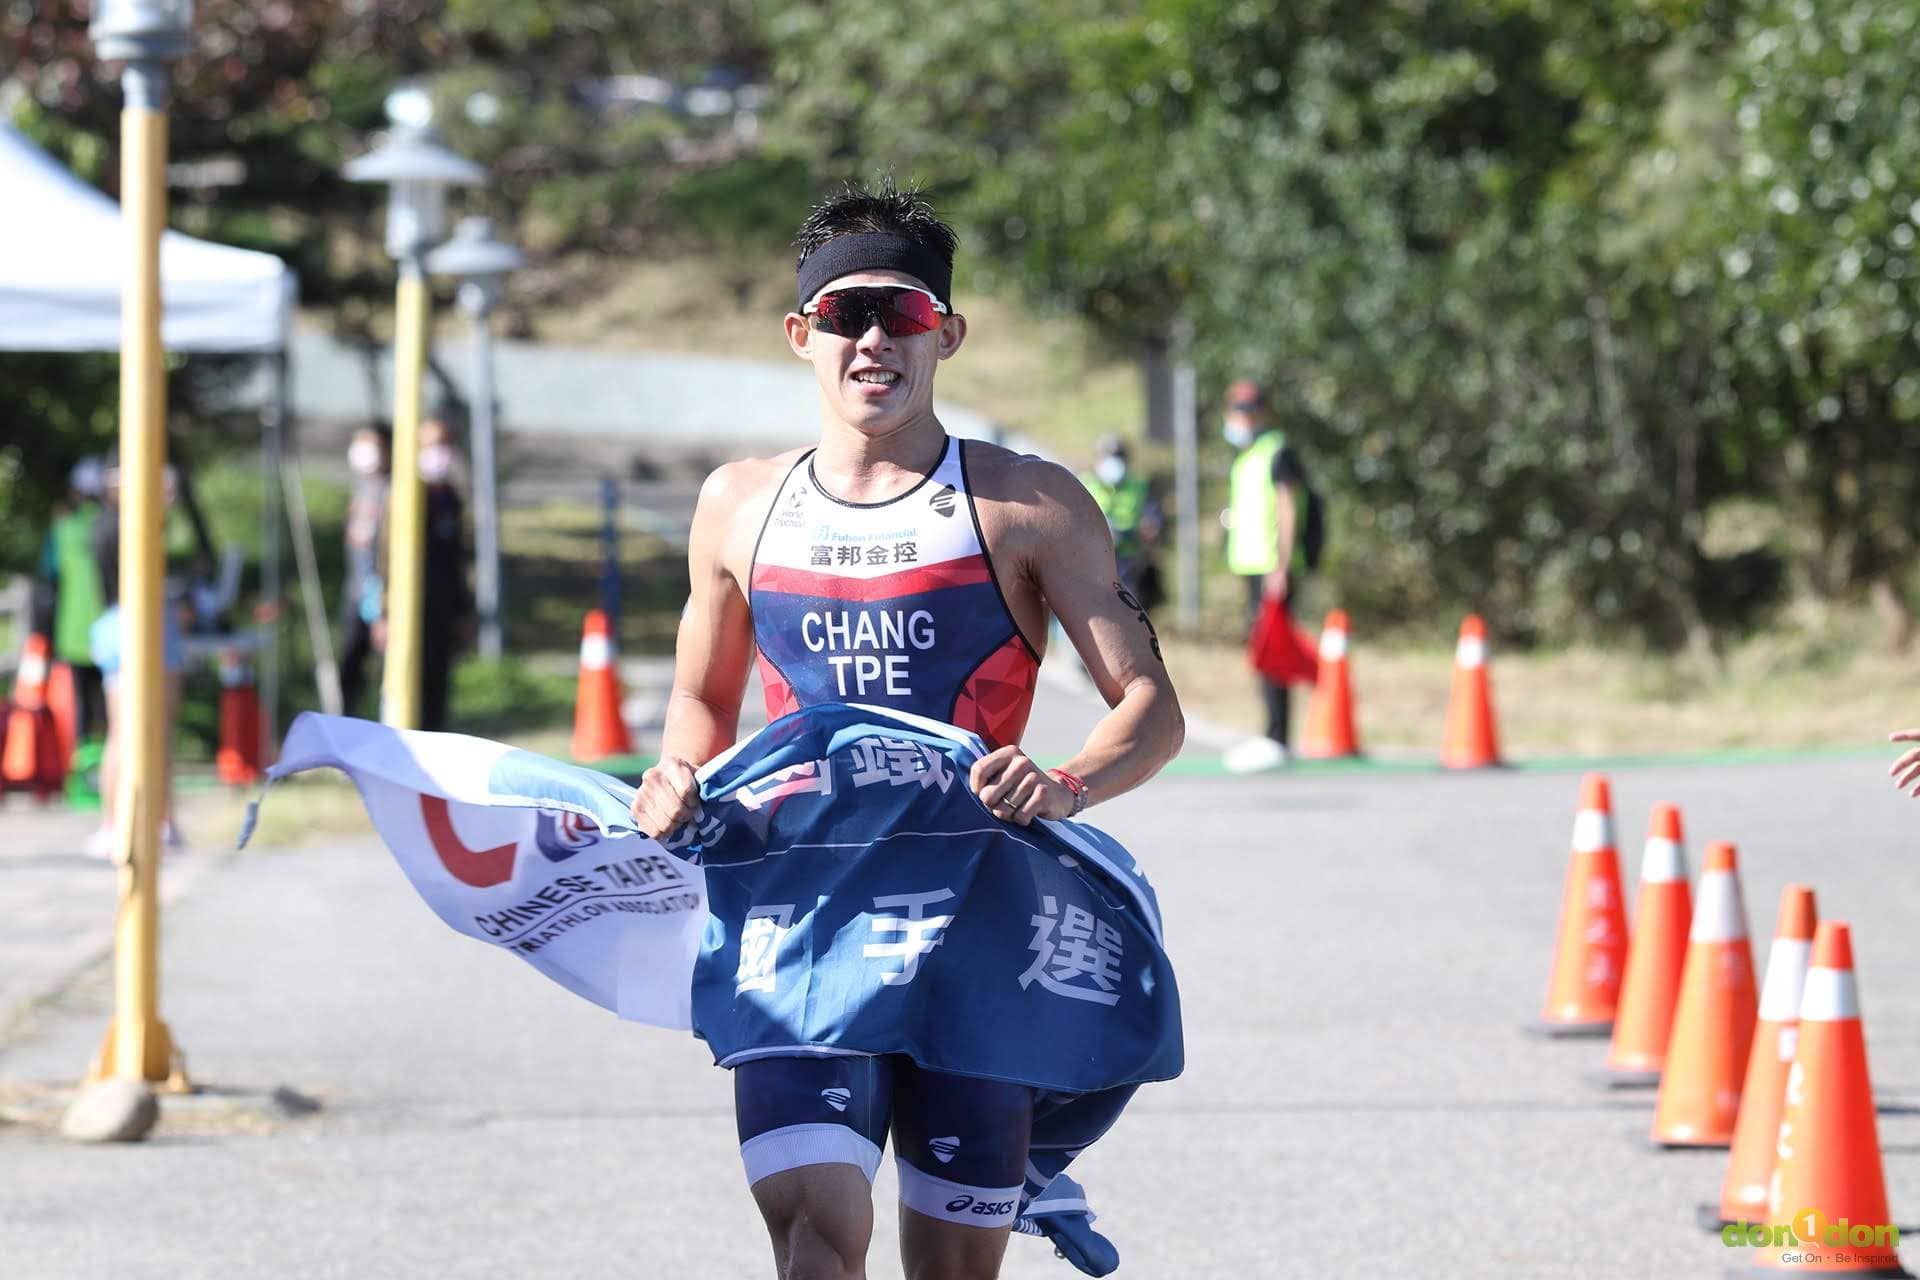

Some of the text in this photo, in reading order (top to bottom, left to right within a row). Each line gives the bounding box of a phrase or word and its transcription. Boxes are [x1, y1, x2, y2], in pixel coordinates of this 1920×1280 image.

[810, 541, 918, 566] 富邦金控
[831, 528, 917, 542] Fubon Financial
[801, 610, 936, 653] CHANG
[828, 655, 912, 696] TPE
[474, 875, 605, 937] CHINESE
[509, 902, 613, 957] TRIATHLON
[971, 1200, 1014, 1216] asics
